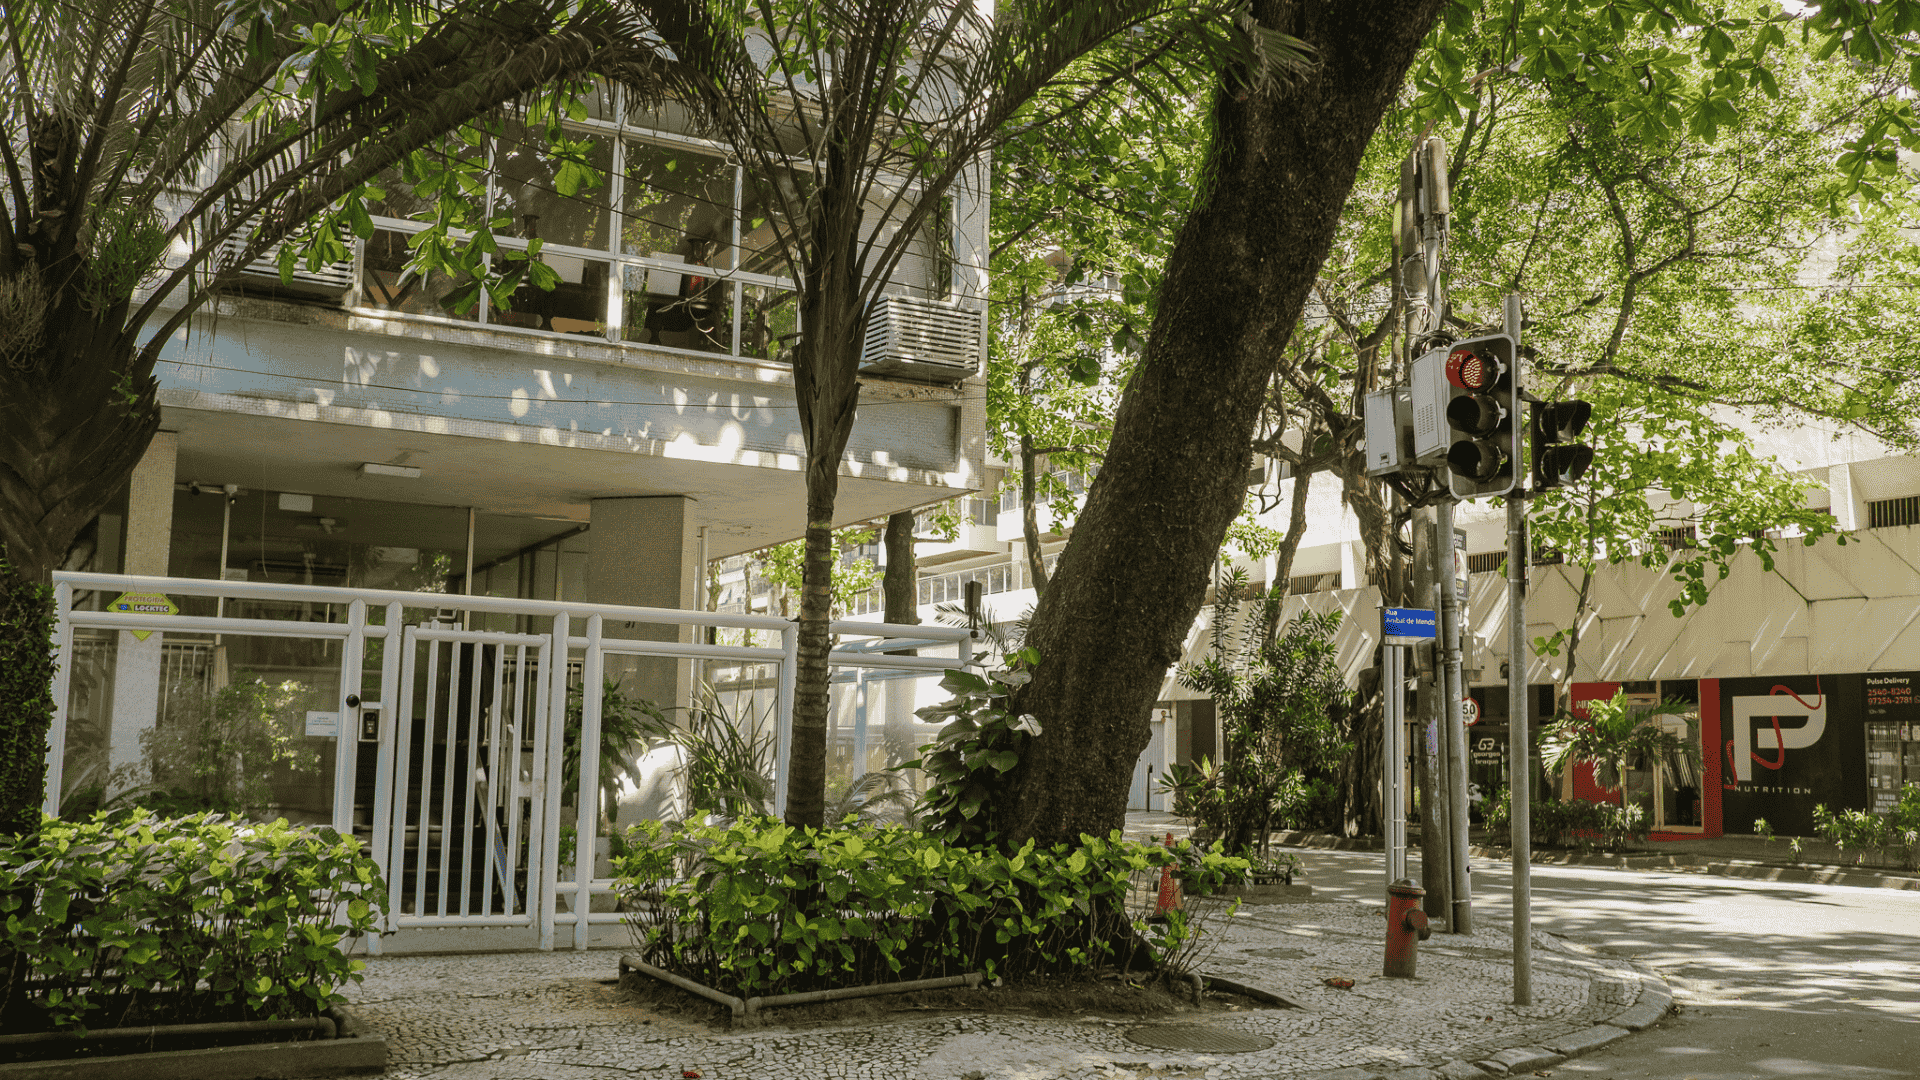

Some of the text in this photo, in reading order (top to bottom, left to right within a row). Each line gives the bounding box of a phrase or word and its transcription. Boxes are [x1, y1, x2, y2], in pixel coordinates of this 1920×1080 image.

[124, 596, 164, 604] PROTEGIDA
[134, 604, 169, 612] LOCKTEC
[1883, 677, 1910, 685] Delivery
[1462, 704, 1476, 715] 50
[1734, 785, 1812, 795] NUTRITION
